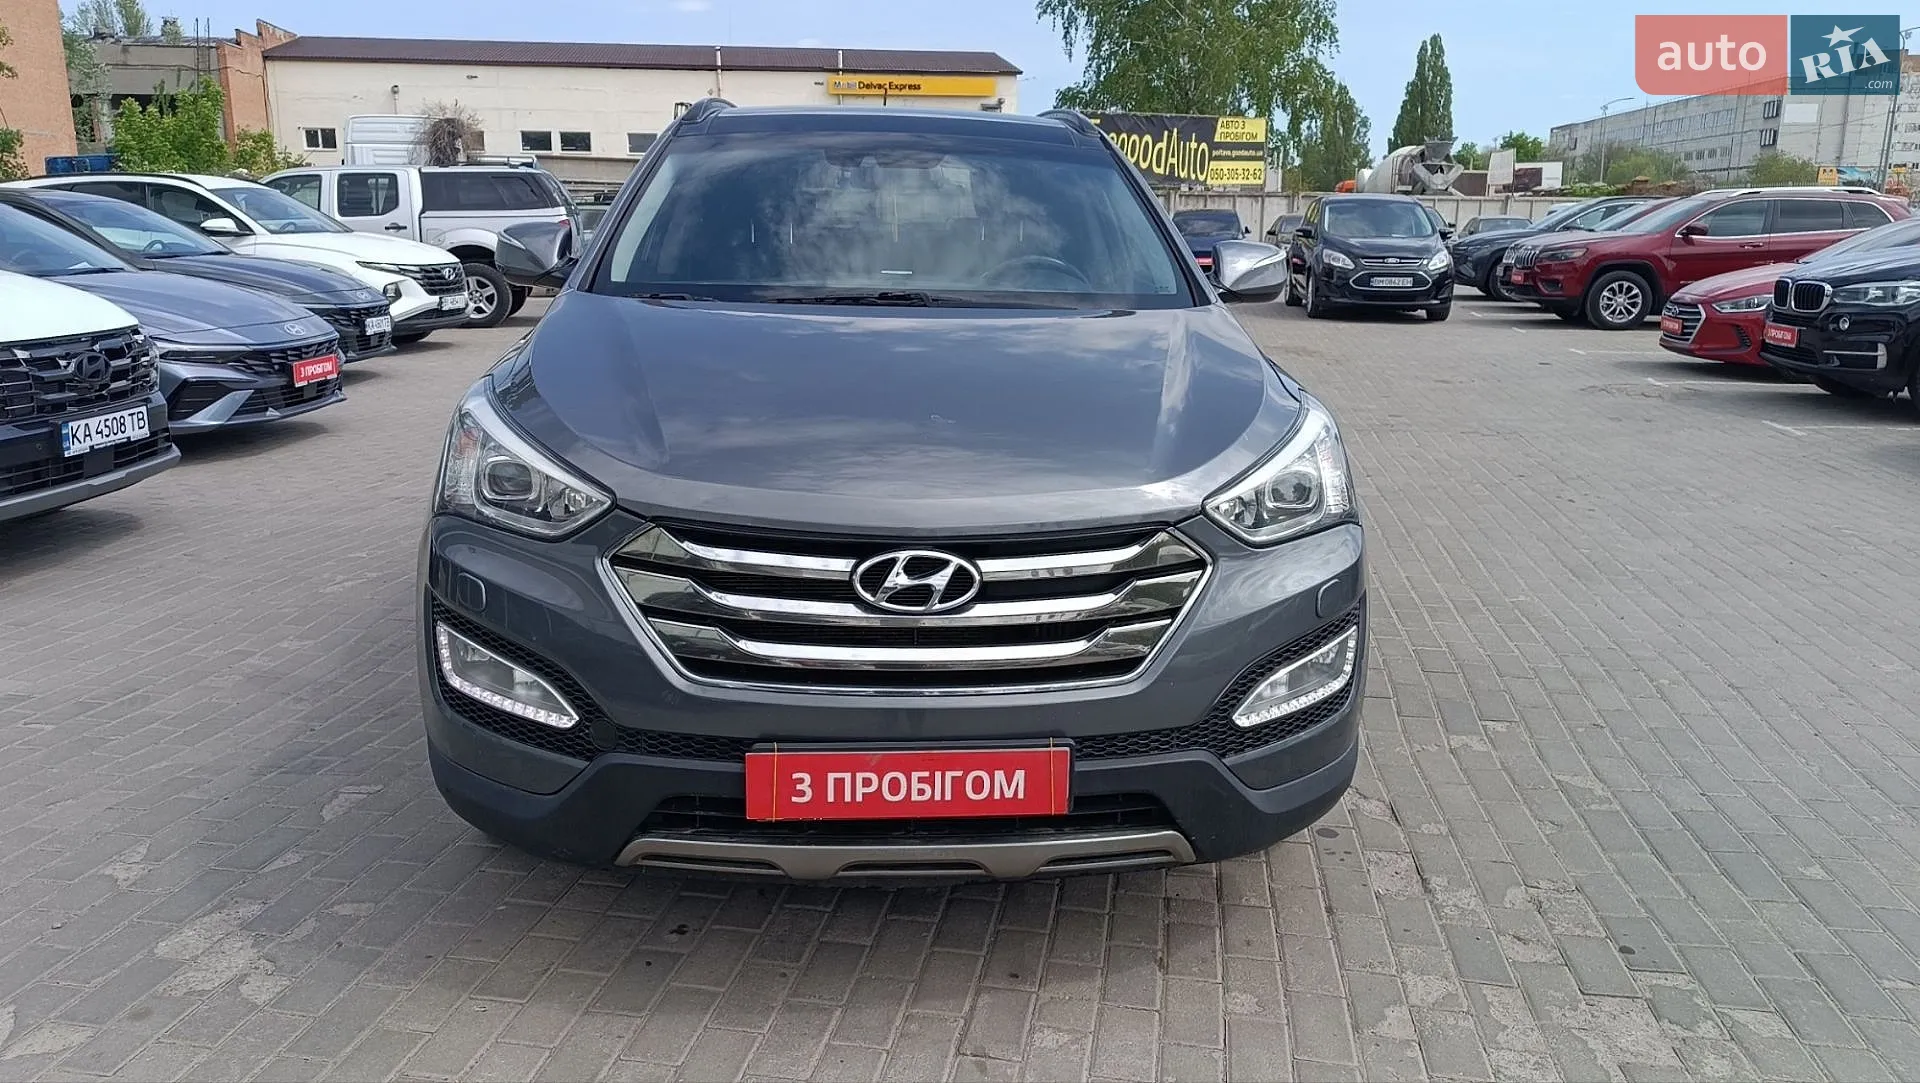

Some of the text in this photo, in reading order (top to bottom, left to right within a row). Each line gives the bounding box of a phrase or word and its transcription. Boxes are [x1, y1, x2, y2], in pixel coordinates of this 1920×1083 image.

[858, 81, 887, 91] Delvac
[889, 81, 922, 91] Express
[1220, 120, 1241, 130] АВТО
[1219, 131, 1258, 141] ПРОБІГОМ
[1209, 168, 1263, 181] 050-305-32-62
[70, 410, 146, 446] KA 4508 TB
[790, 769, 1026, 803] З ПРОБІГОМ
